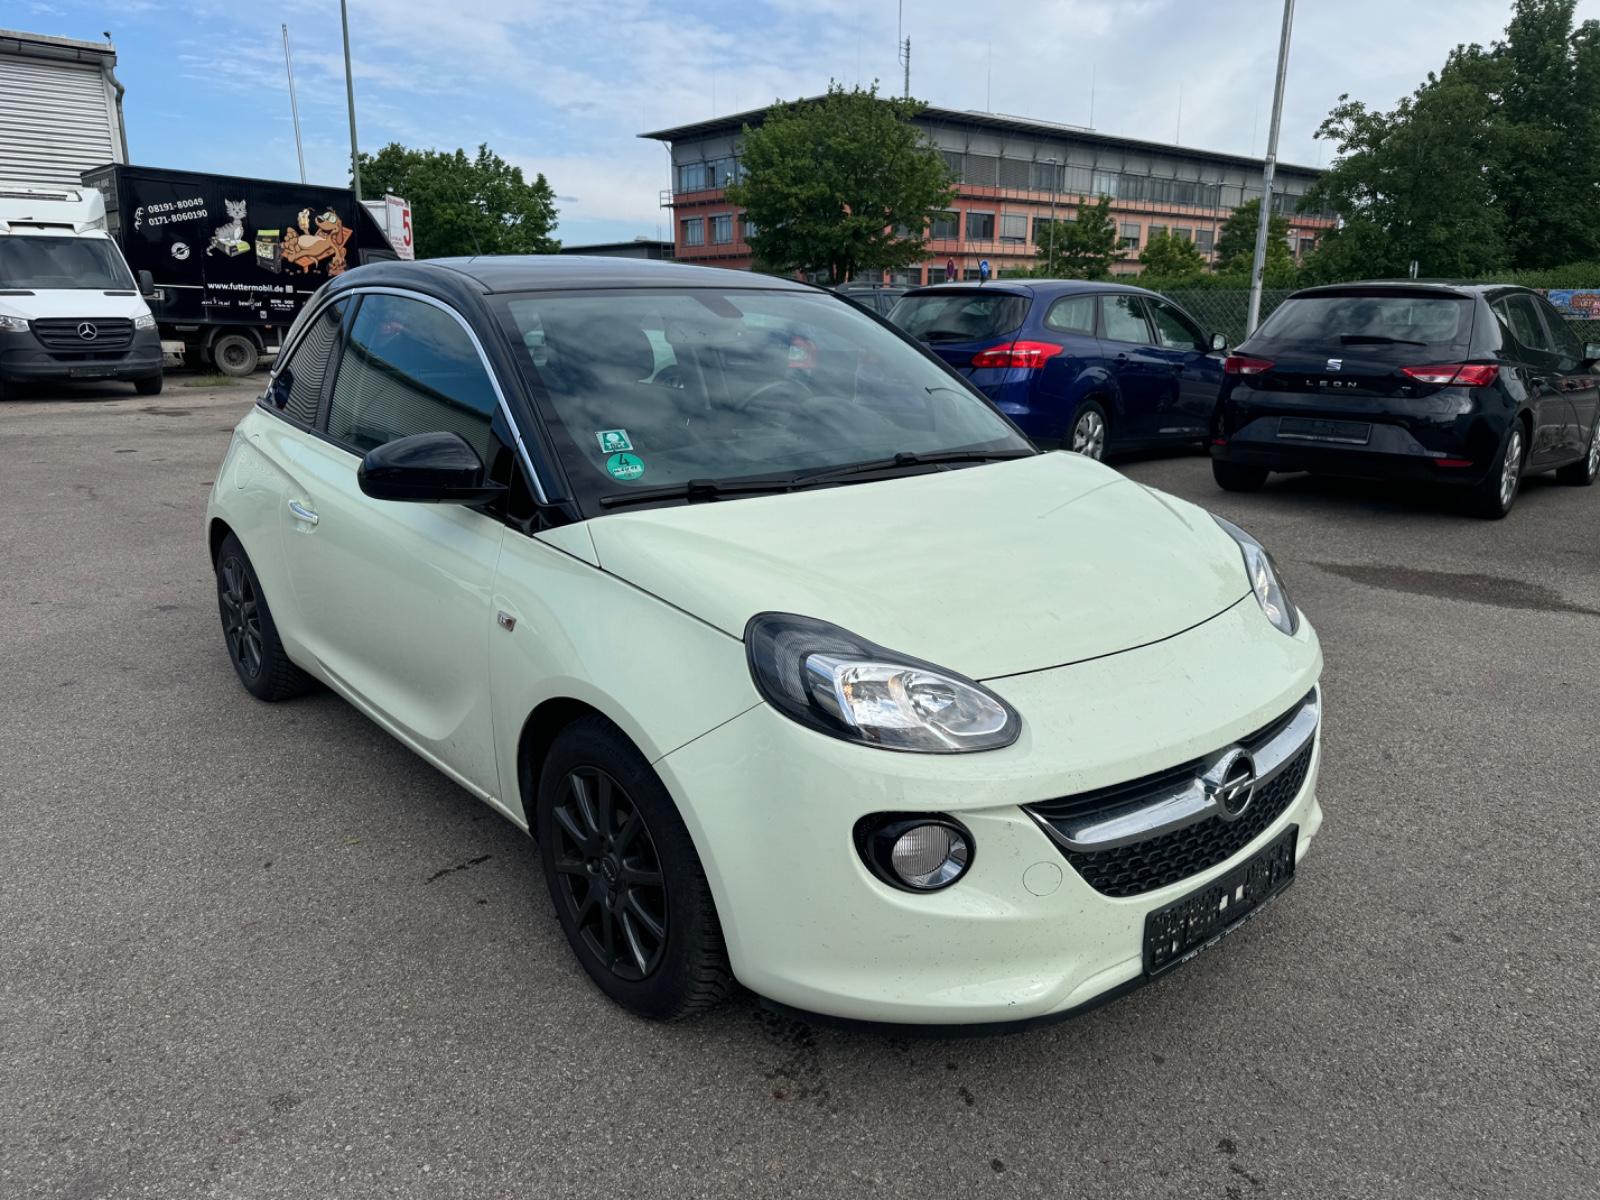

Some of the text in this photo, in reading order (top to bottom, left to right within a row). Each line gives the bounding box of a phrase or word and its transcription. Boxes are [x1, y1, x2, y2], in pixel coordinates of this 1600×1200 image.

[148, 197, 204, 213] 08191-80049
[148, 209, 208, 226] 0171-8060190
[402, 209, 411, 247] 5
[207, 282, 284, 293] www.futtermobil.de
[1306, 380, 1357, 388] LEON
[619, 454, 630, 466] 4
